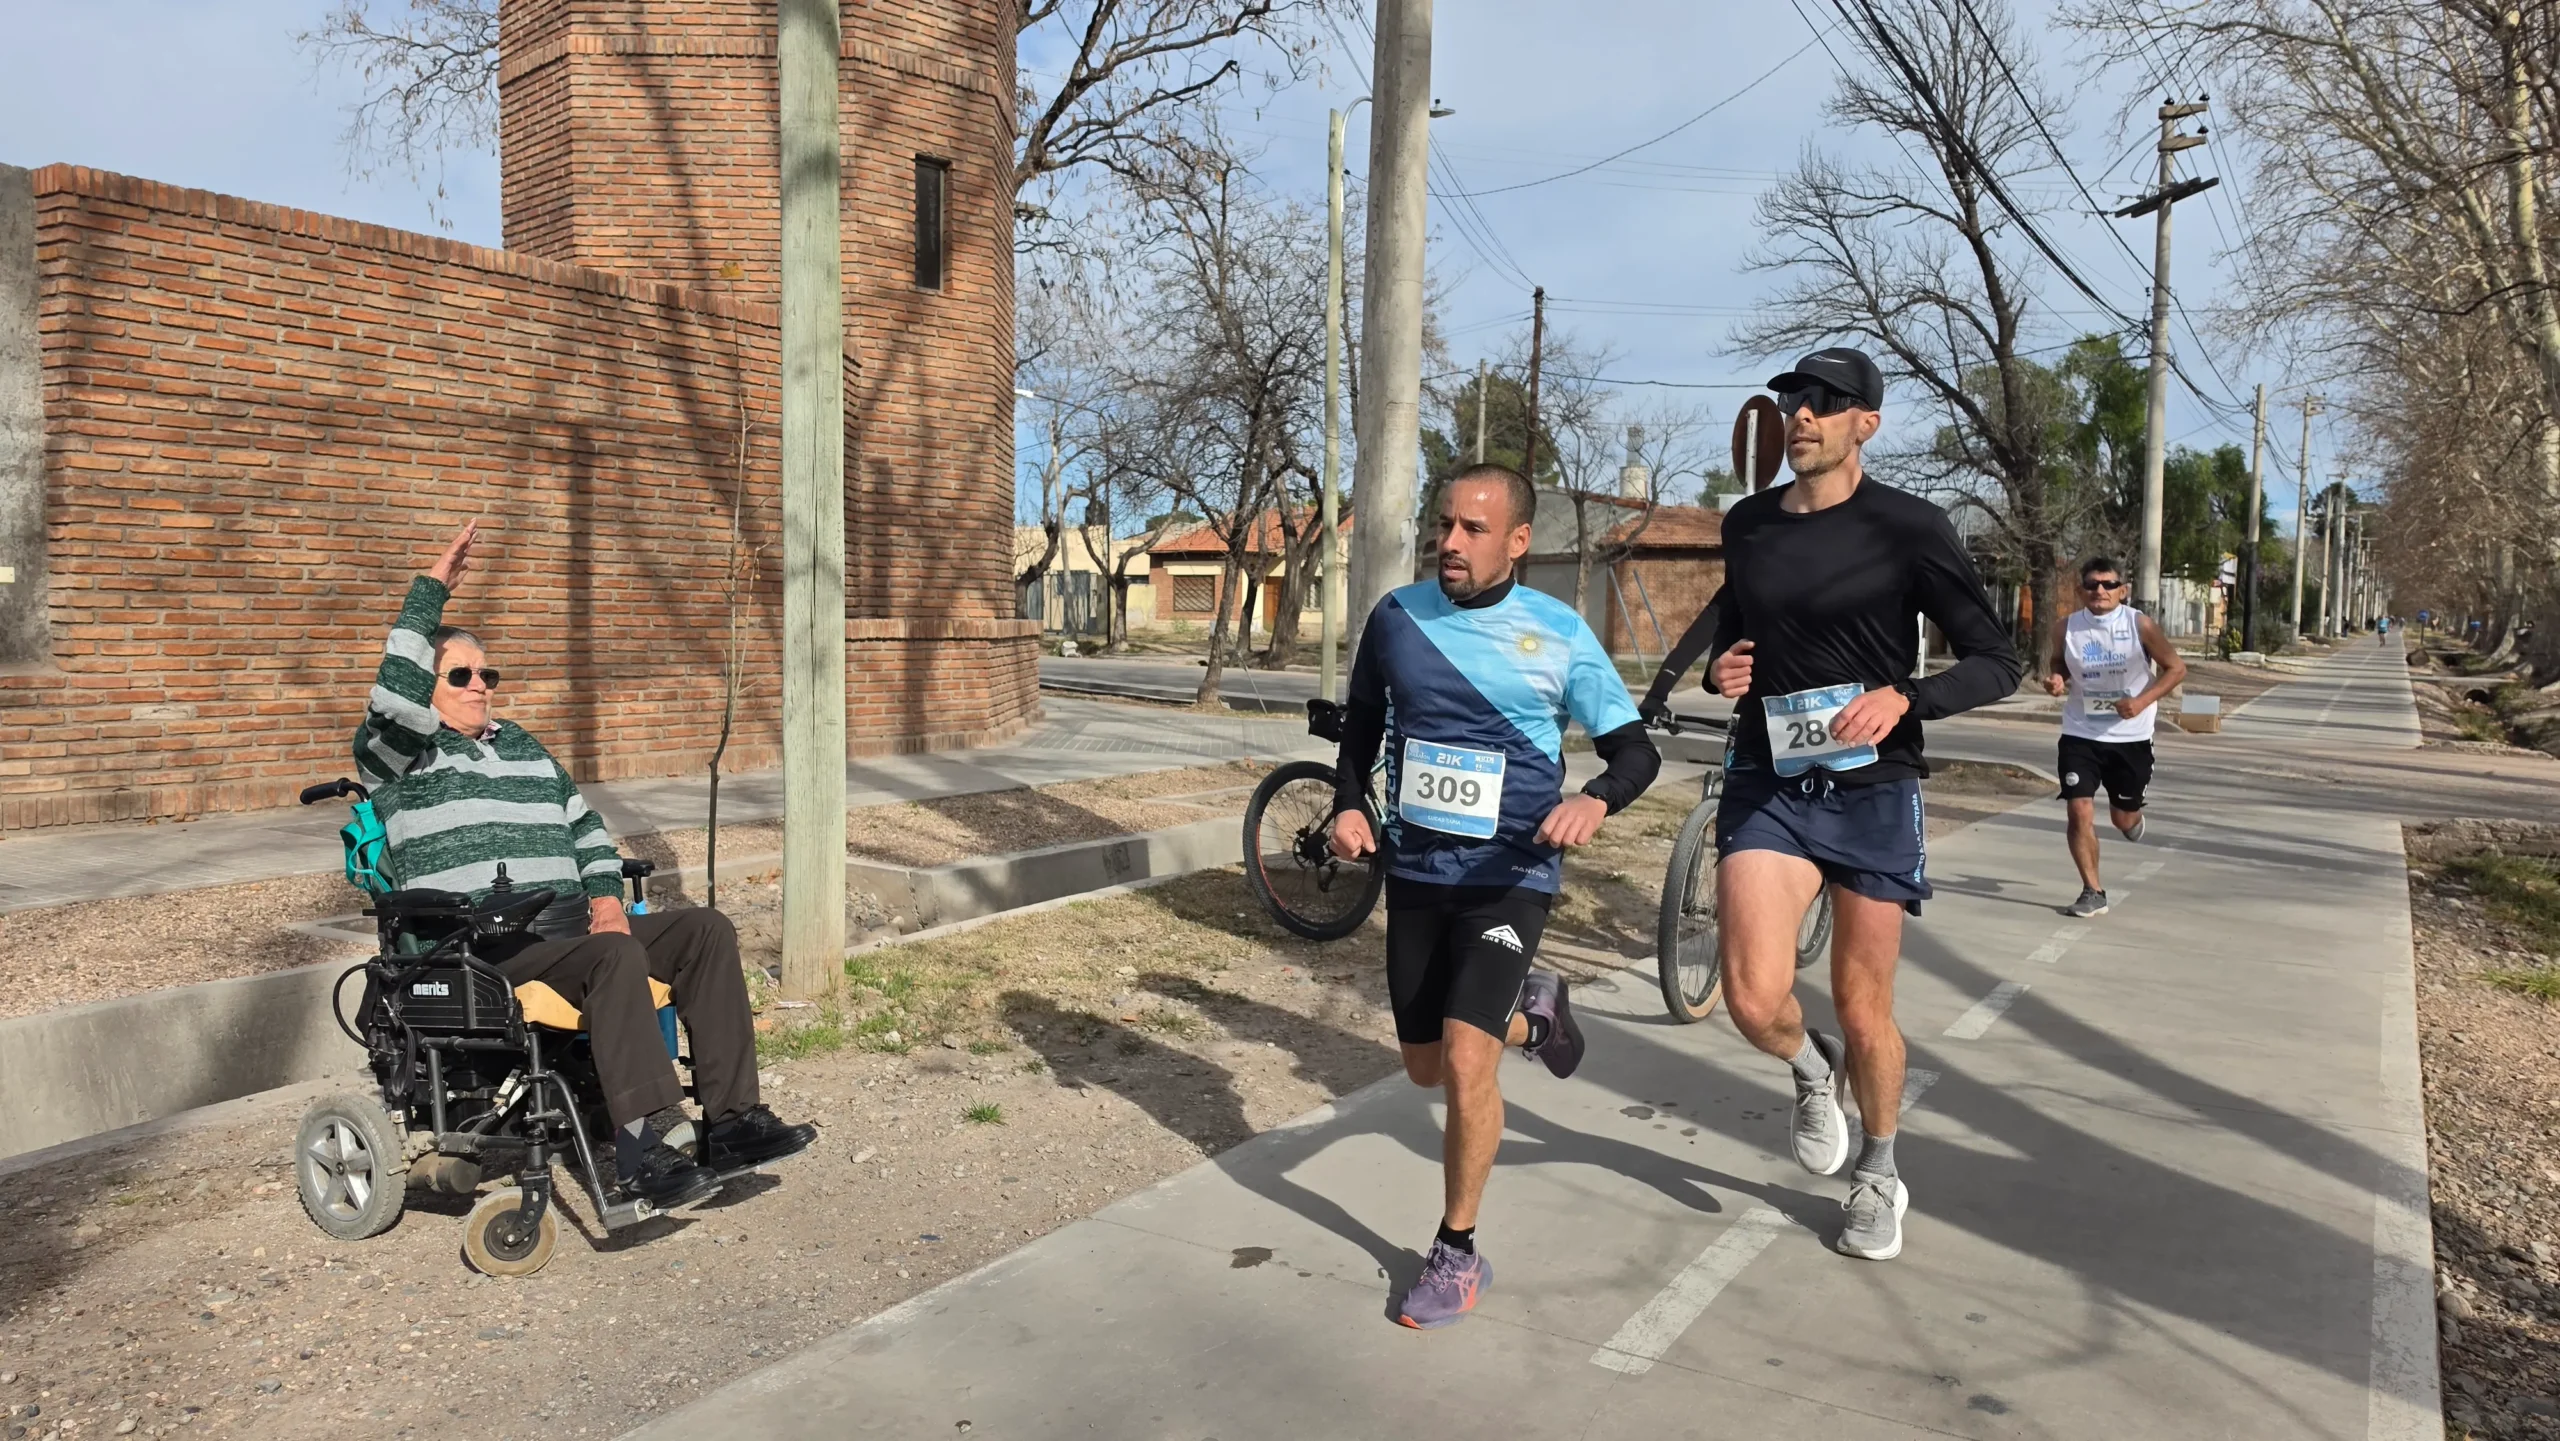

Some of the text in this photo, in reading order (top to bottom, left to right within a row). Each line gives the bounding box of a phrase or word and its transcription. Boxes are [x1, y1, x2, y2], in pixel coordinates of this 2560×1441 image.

[1797, 696, 1822, 710] 21K
[2092, 699, 2115, 711] 22
[1786, 719, 1837, 749] 28
[1435, 752, 1464, 767] 21K
[1416, 772, 1481, 807] 309
[1511, 865, 1549, 879] PANTRO
[1481, 934, 1523, 954] NIKE TRAIL
